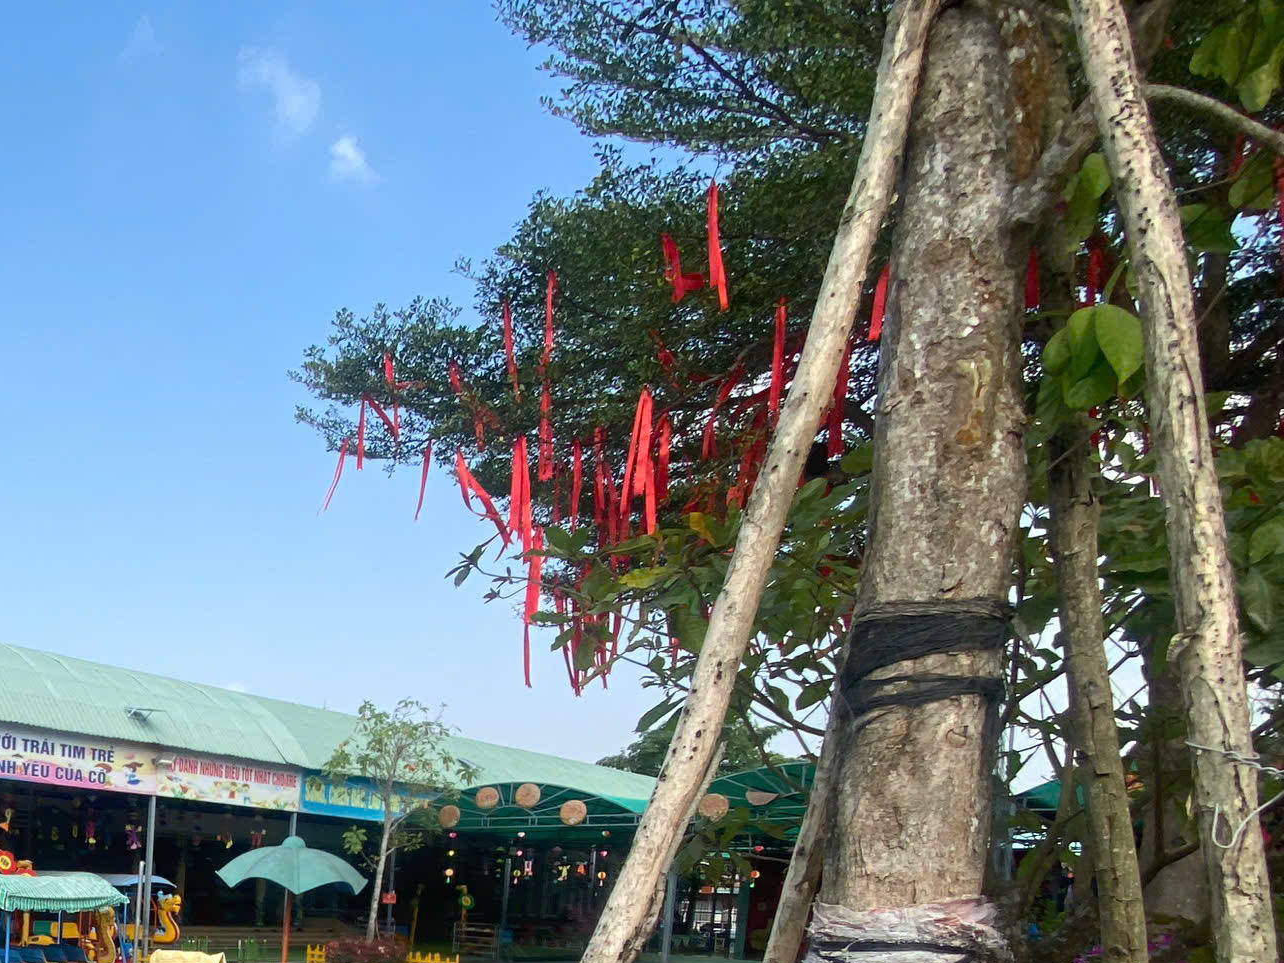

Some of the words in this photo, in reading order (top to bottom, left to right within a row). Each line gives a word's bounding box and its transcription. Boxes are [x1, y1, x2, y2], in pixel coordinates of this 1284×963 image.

[22, 738, 55, 756] TRÁI
[60, 744, 85, 760] TIM
[90, 746, 115, 763] TRẺ
[22, 761, 50, 777] YÊU
[55, 763, 83, 782] CỦA
[88, 769, 107, 784] CÔ
